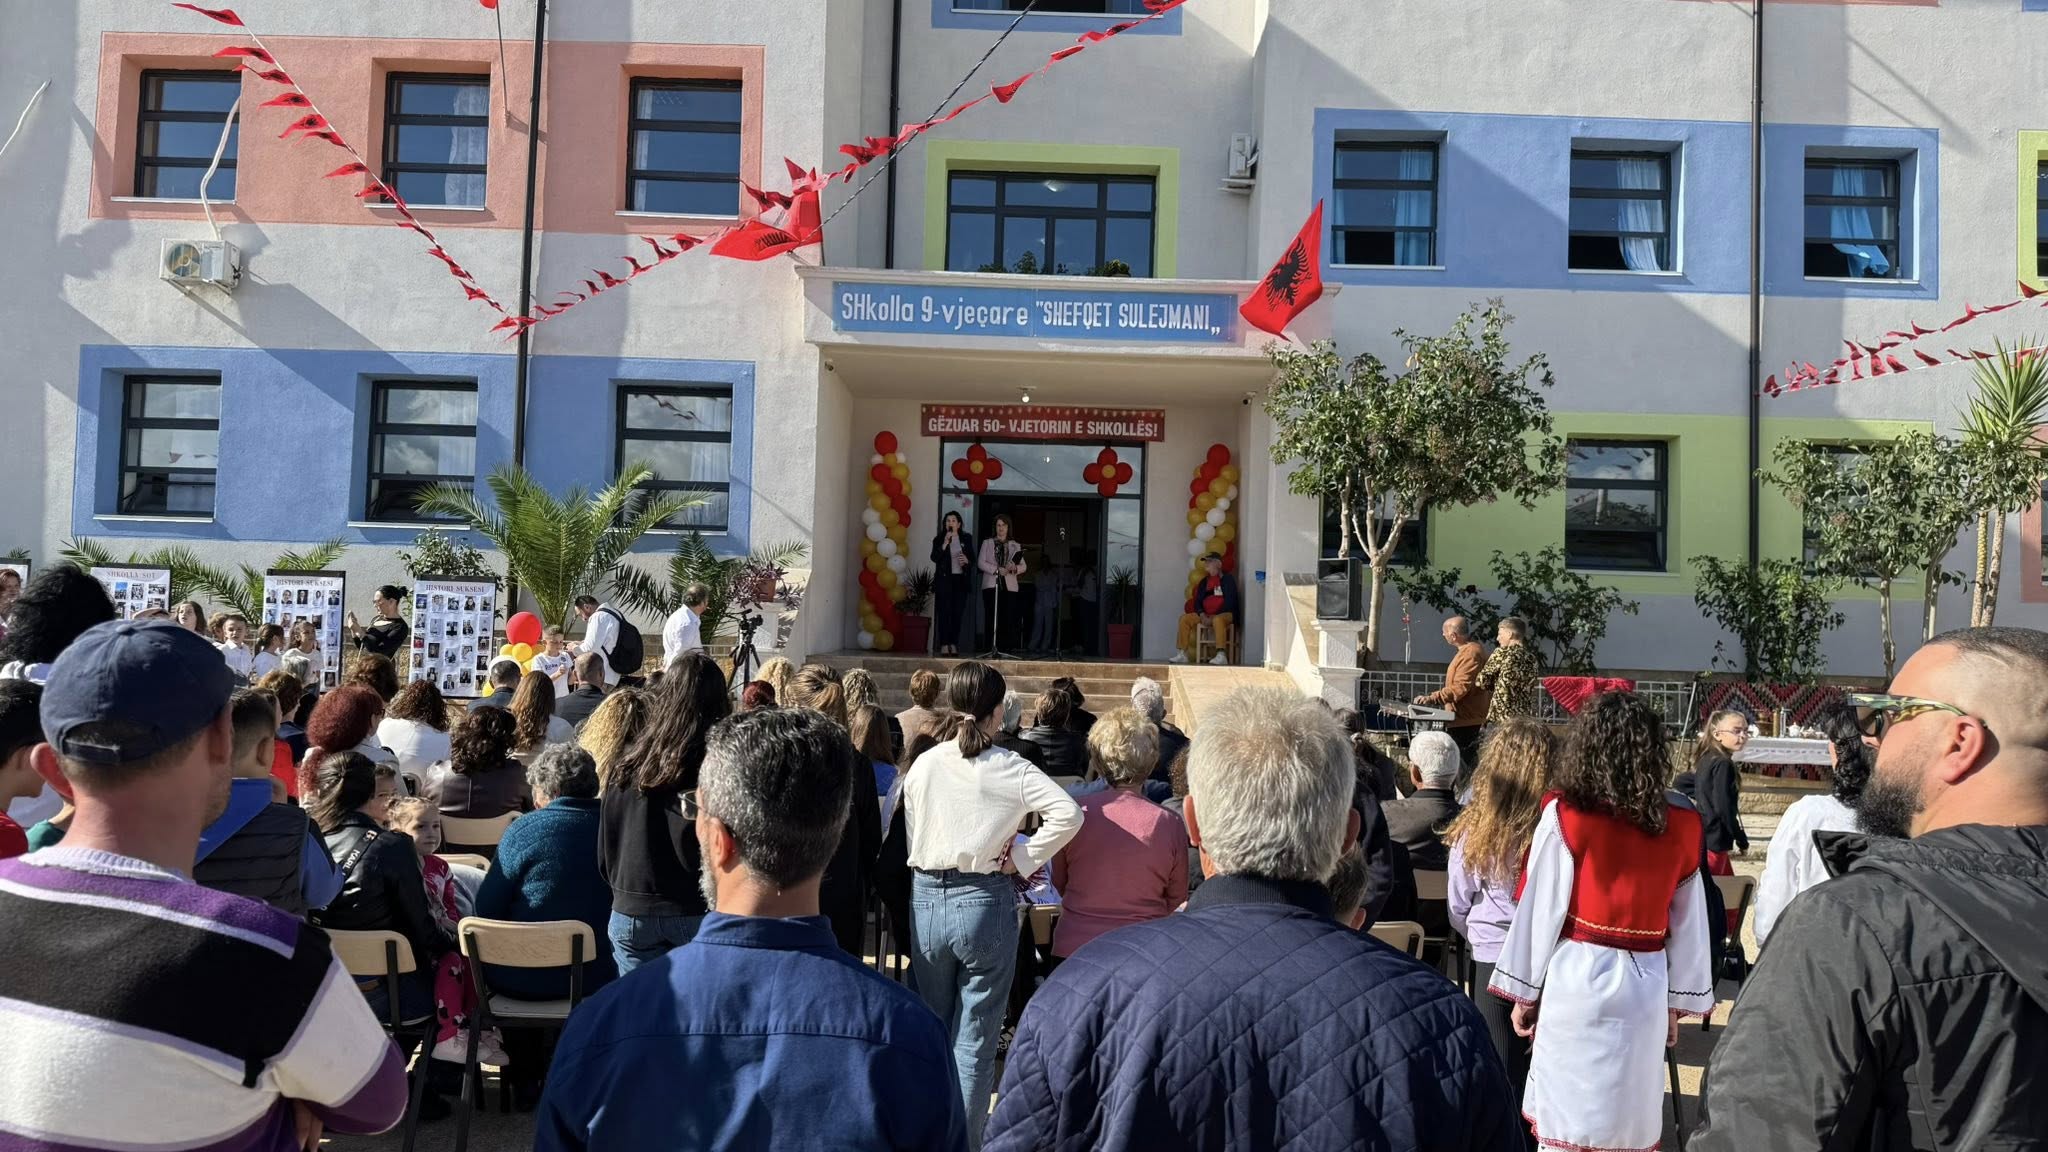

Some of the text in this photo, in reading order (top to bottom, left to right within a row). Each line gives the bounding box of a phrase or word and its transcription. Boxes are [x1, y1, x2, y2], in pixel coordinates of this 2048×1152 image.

[921, 295, 1029, 330] 9-vjeçare
[928, 415, 1158, 437] GËZUAR 50- VJETORIN E SHKOLLËS!
[107, 570, 139, 579] SHKOLLA
[276, 578, 304, 586] HISTORI
[425, 584, 485, 593] HISTORI SUKSESI
[342, 849, 360, 869] KARL
